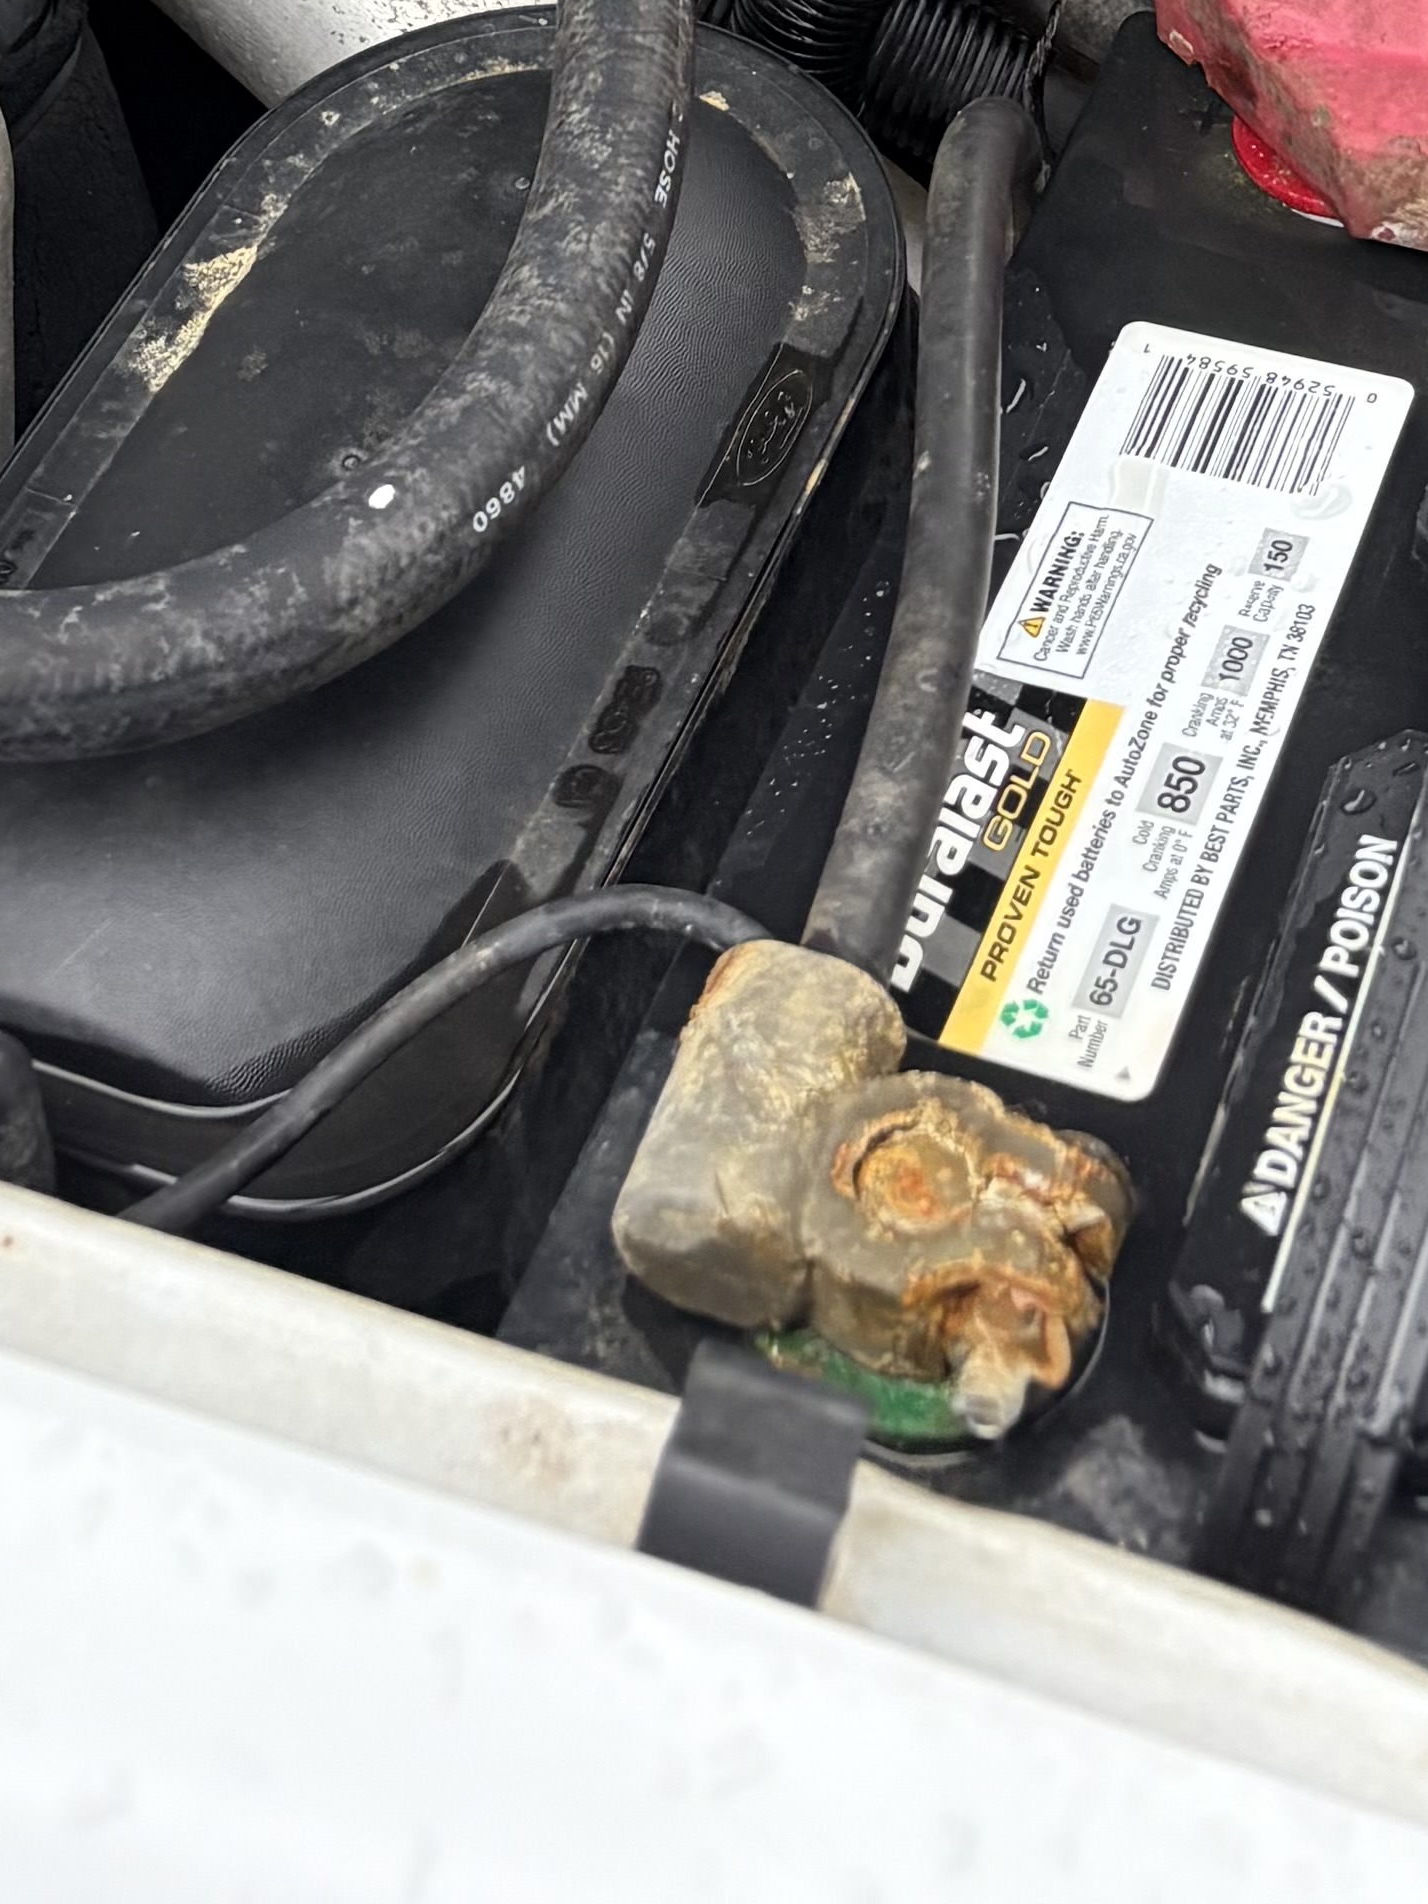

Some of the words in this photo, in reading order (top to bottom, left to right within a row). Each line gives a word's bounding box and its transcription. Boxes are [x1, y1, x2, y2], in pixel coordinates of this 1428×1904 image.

[654, 129, 681, 208] HOSE
[633, 233, 656, 283] 5/8
[614, 289, 635, 326] IN
[1186, 353, 1254, 380] 59584
[1264, 372, 1336, 397] 52948
[546, 381, 589, 448] MM)
[1366, 392, 1378, 404] 0
[471, 464, 528, 533] 4860
[1029, 530, 1085, 613] WARNING:
[1262, 538, 1294, 573] 150
[1033, 624, 1059, 661] Cancer
[1052, 604, 1069, 624] and
[1064, 542, 1098, 604] Reproductive
[1089, 514, 1109, 542] Harm.
[1055, 625, 1076, 654] Wash
[1071, 591, 1093, 622] hands
[1084, 569, 1102, 592] after
[1181, 563, 1223, 629] recycling
[1238, 579, 1266, 618] Reserve
[1253, 583, 1285, 623] Capacity
[1286, 603, 1317, 643] 38103
[1160, 626, 1192, 685] proper
[1218, 635, 1254, 682] 1000
[1277, 643, 1301, 662] TN
[1146, 682, 1170, 709] for
[1181, 692, 1215, 738] Cranking
[1205, 696, 1229, 727] Amps
[1113, 709, 1159, 789] AutoZone
[982, 731, 1052, 852] GOLD
[1111, 788, 1125, 810] to
[1156, 755, 1206, 814] 850
[1215, 776, 1255, 824] PARTS,
[1072, 806, 1117, 889] batteries
[1132, 819, 1155, 846] Cold
[1142, 825, 1177, 873] Cranking
[1200, 824, 1230, 863] BEST
[980, 864, 1042, 983] PROVEN
[1031, 769, 1083, 858] TOUGH
[1153, 863, 1179, 900] Amps
[1190, 863, 1214, 886] BY
[1059, 883, 1084, 929] used
[1026, 928, 1066, 995] Return
[1088, 915, 1144, 1007] 65-DLG
[1150, 887, 1205, 991] DISTRIBUTED
[1068, 1014, 1092, 1041] Part
[1253, 1010, 1344, 1190] DANGER
[1319, 833, 1400, 979] POISON
[1076, 1018, 1110, 1069] Number
